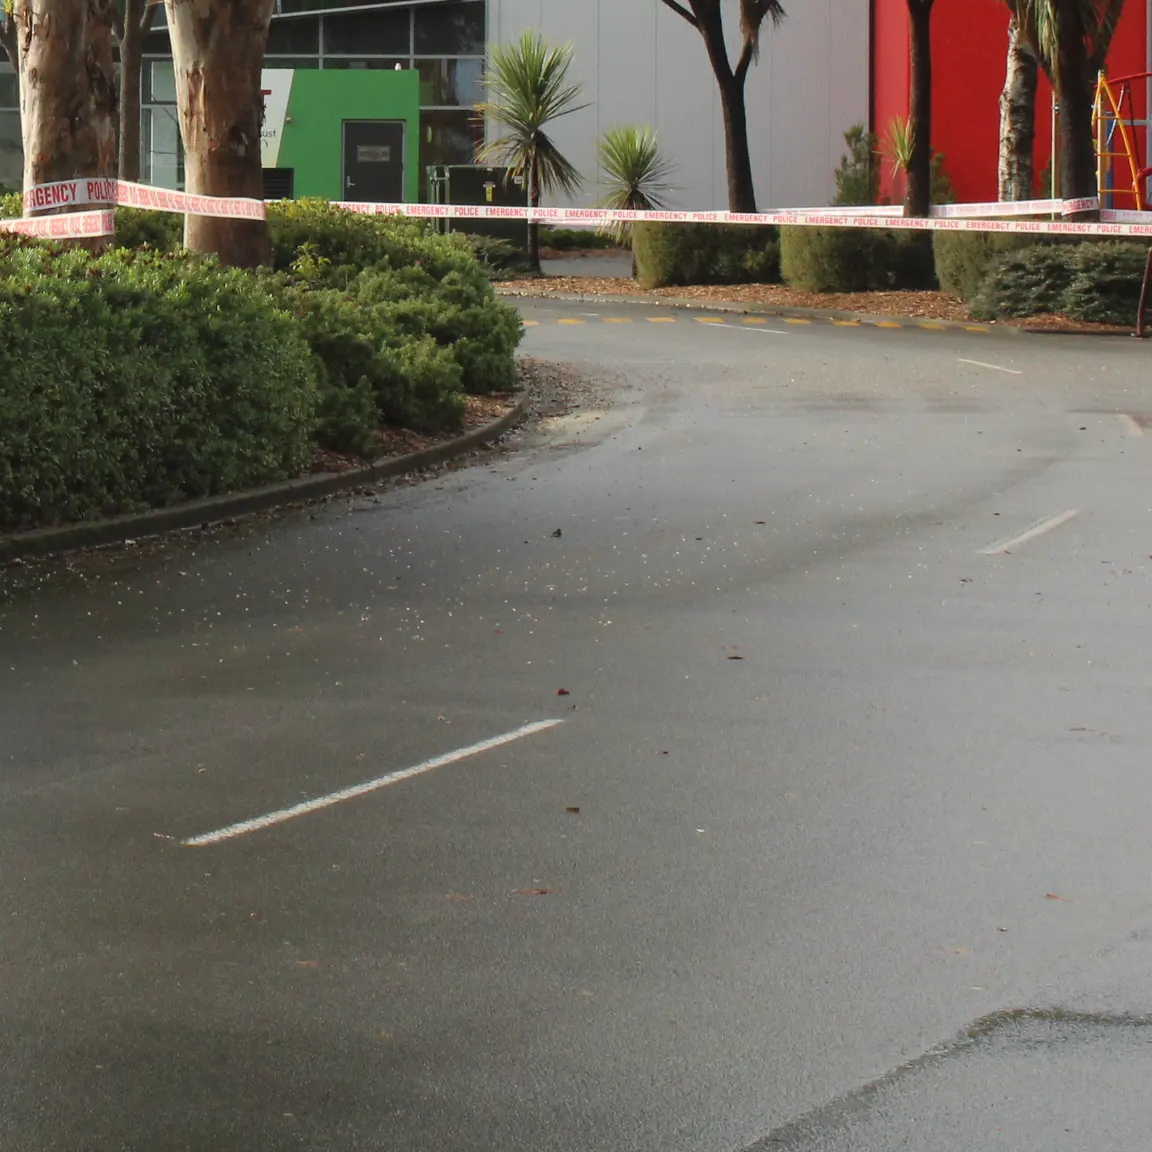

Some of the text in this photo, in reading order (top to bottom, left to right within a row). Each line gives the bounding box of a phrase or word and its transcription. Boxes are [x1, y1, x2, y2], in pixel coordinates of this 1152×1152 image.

[25, 183, 77, 207] RGENCY
[375, 205, 400, 215] POLICE
[406, 205, 448, 216] EMERGENCY
[454, 207, 479, 216] POLICE
[485, 208, 528, 217] EMERGENCY
[533, 209, 558, 217] POLICE
[565, 210, 608, 218] EMERGENCY
[613, 211, 638, 219] POLICE
[644, 211, 687, 220] EMERGENCY
[693, 213, 717, 221] POLICE
[724, 213, 768, 223] EMERGENCY
[773, 215, 798, 223] POLICE
[804, 216, 848, 225] EMERGENCY
[853, 218, 879, 226] POLICE
[885, 219, 929, 227] EMERGENCY
[934, 220, 959, 229] POLICE
[966, 221, 1009, 230] EMERGENCY
[1015, 223, 1041, 231] POLICE
[1047, 223, 1091, 232] EMERGENCY
[1097, 224, 1122, 233] POLICE
